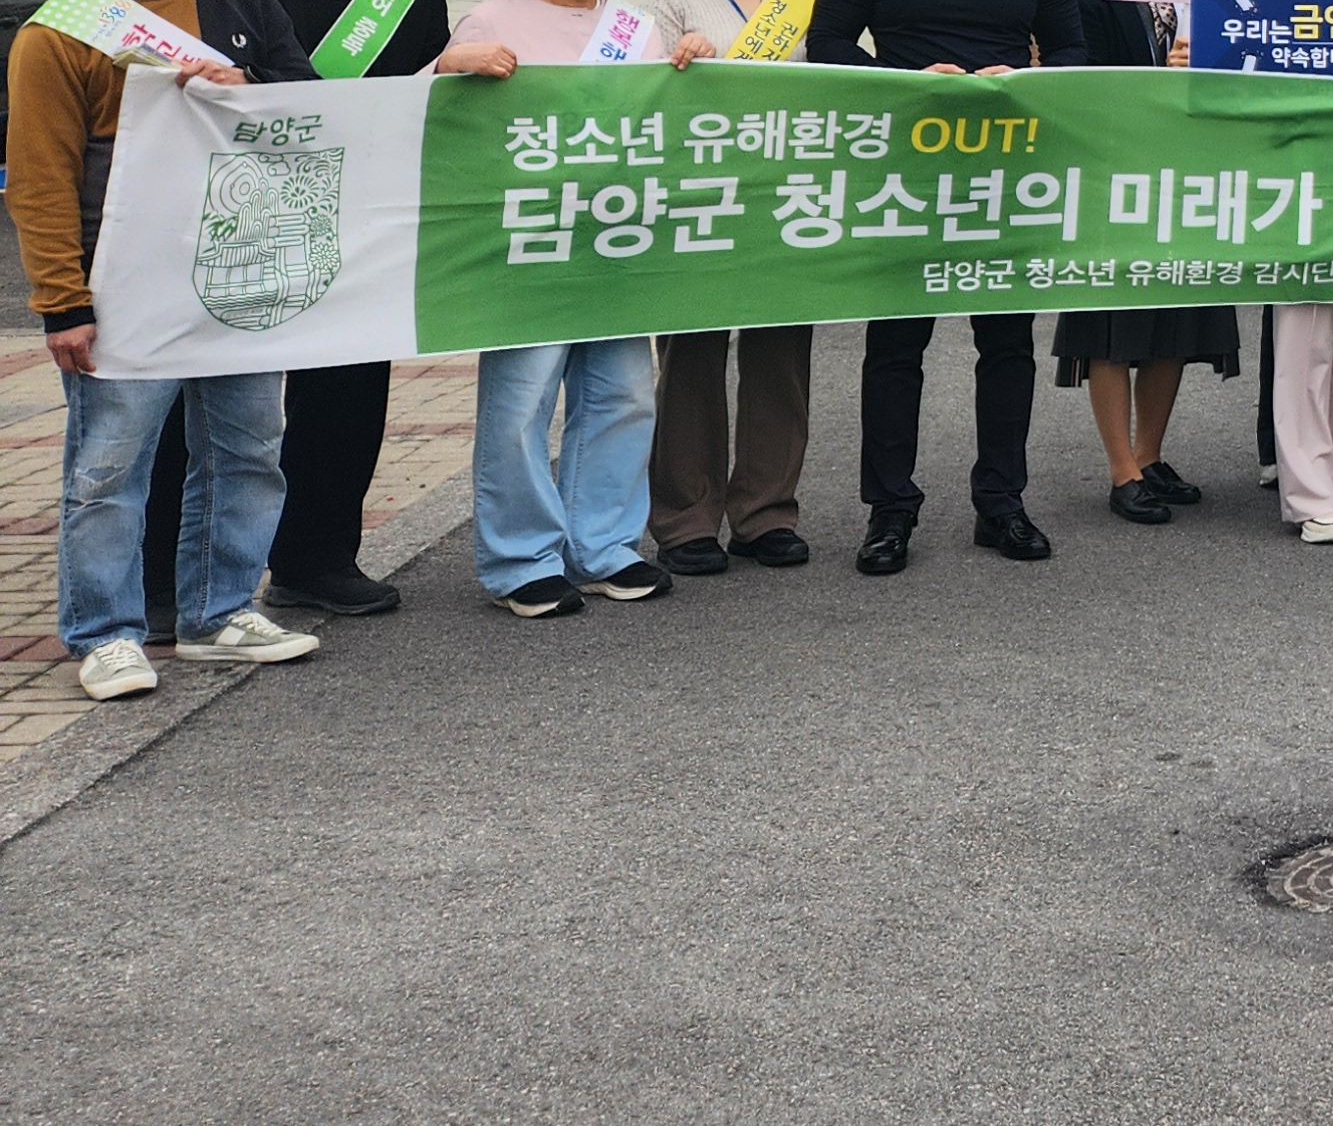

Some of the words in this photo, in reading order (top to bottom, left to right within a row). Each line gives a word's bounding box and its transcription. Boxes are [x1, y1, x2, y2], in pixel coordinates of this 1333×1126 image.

[1221, 18, 1292, 44] 우리는
[232, 114, 323, 142] 담양군
[504, 111, 665, 171] 청소년
[683, 108, 892, 164] 유해환경
[910, 117, 1039, 154] OUT!
[502, 176, 745, 264] 담양군
[772, 166, 1081, 249] 청소년의
[1108, 168, 1324, 245] 미래가
[922, 260, 1016, 293] 담양군
[1025, 259, 1115, 288] 청소년
[1125, 260, 1243, 286] 유해환경
